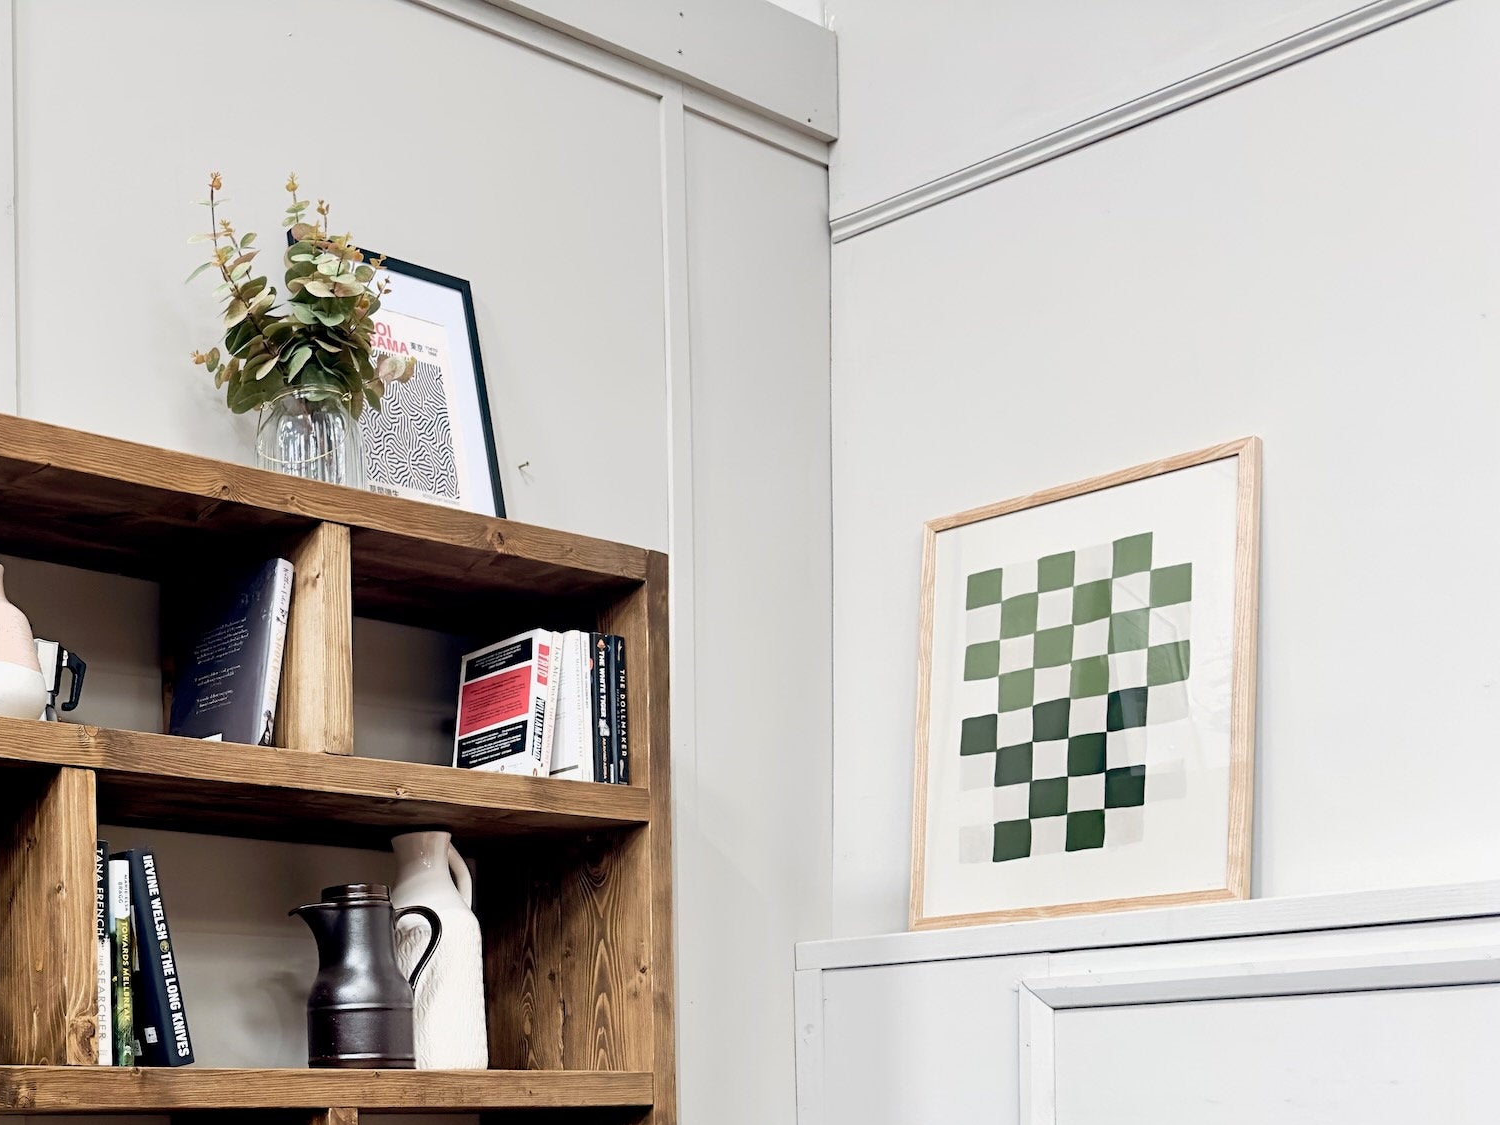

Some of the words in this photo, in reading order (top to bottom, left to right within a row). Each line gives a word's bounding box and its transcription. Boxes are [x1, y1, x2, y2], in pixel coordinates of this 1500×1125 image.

[369, 336, 409, 355] SAMA
[96, 848, 104, 882] TANA
[142, 854, 160, 896] IRVINE
[96, 887, 105, 937] FRENCH
[150, 897, 168, 940] WELSH
[122, 921, 130, 966] TOWARDS
[160, 951, 175, 977] THE
[98, 968, 106, 1039] SEARCHER
[165, 977, 182, 1010] LONG
[171, 1012, 190, 1057] KNIVES
